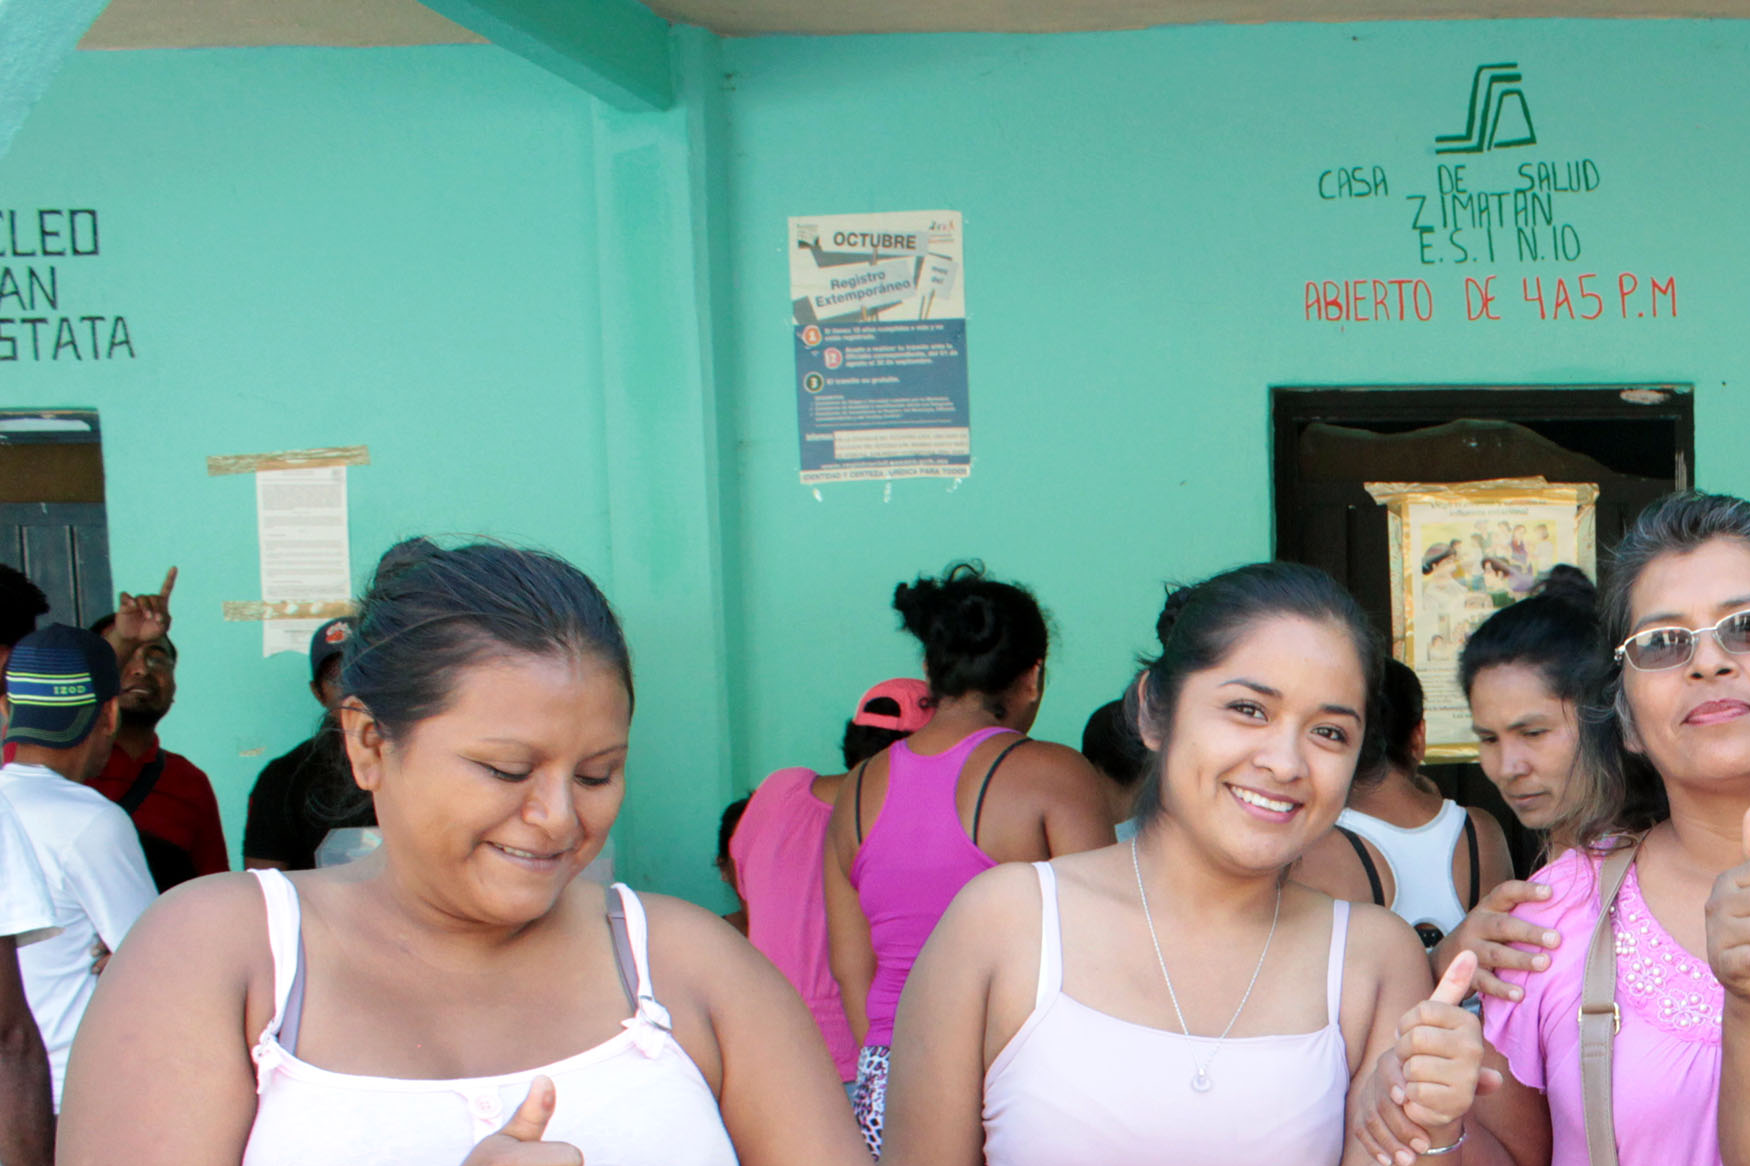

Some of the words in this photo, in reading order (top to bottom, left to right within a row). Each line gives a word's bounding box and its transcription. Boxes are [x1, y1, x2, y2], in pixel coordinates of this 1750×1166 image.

[1318, 165, 1389, 200] CASA
[1437, 164, 1467, 195] DE
[1517, 158, 1600, 193] SALUD
[0, 209, 99, 256] LEO
[833, 232, 917, 249] OCTUBRE
[815, 279, 911, 307] Extemporáneo
[830, 271, 886, 290] Registro
[1304, 278, 1433, 322] ABIERTO
[1465, 275, 1500, 322] DE
[53, 685, 86, 695] IZOD
